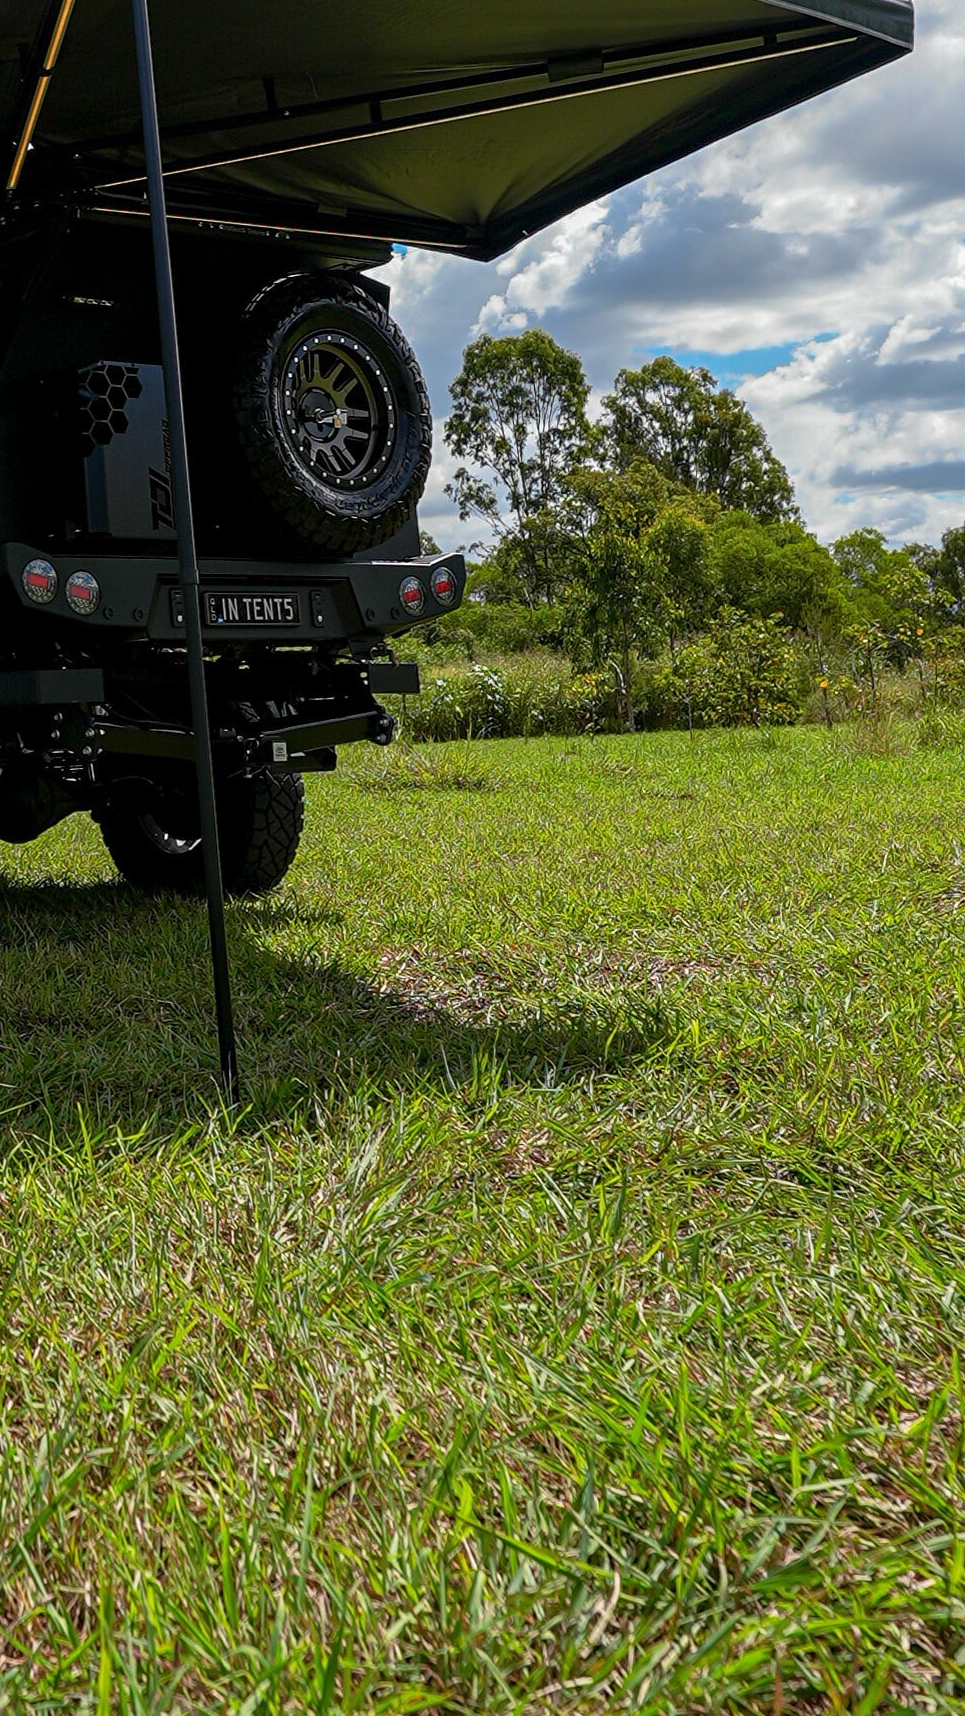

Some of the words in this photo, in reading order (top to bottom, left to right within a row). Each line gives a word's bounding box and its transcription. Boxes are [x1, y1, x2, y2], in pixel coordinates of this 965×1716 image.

[147, 466, 174, 531] TDI
[209, 597, 218, 621] QLD
[221, 597, 240, 621] IN
